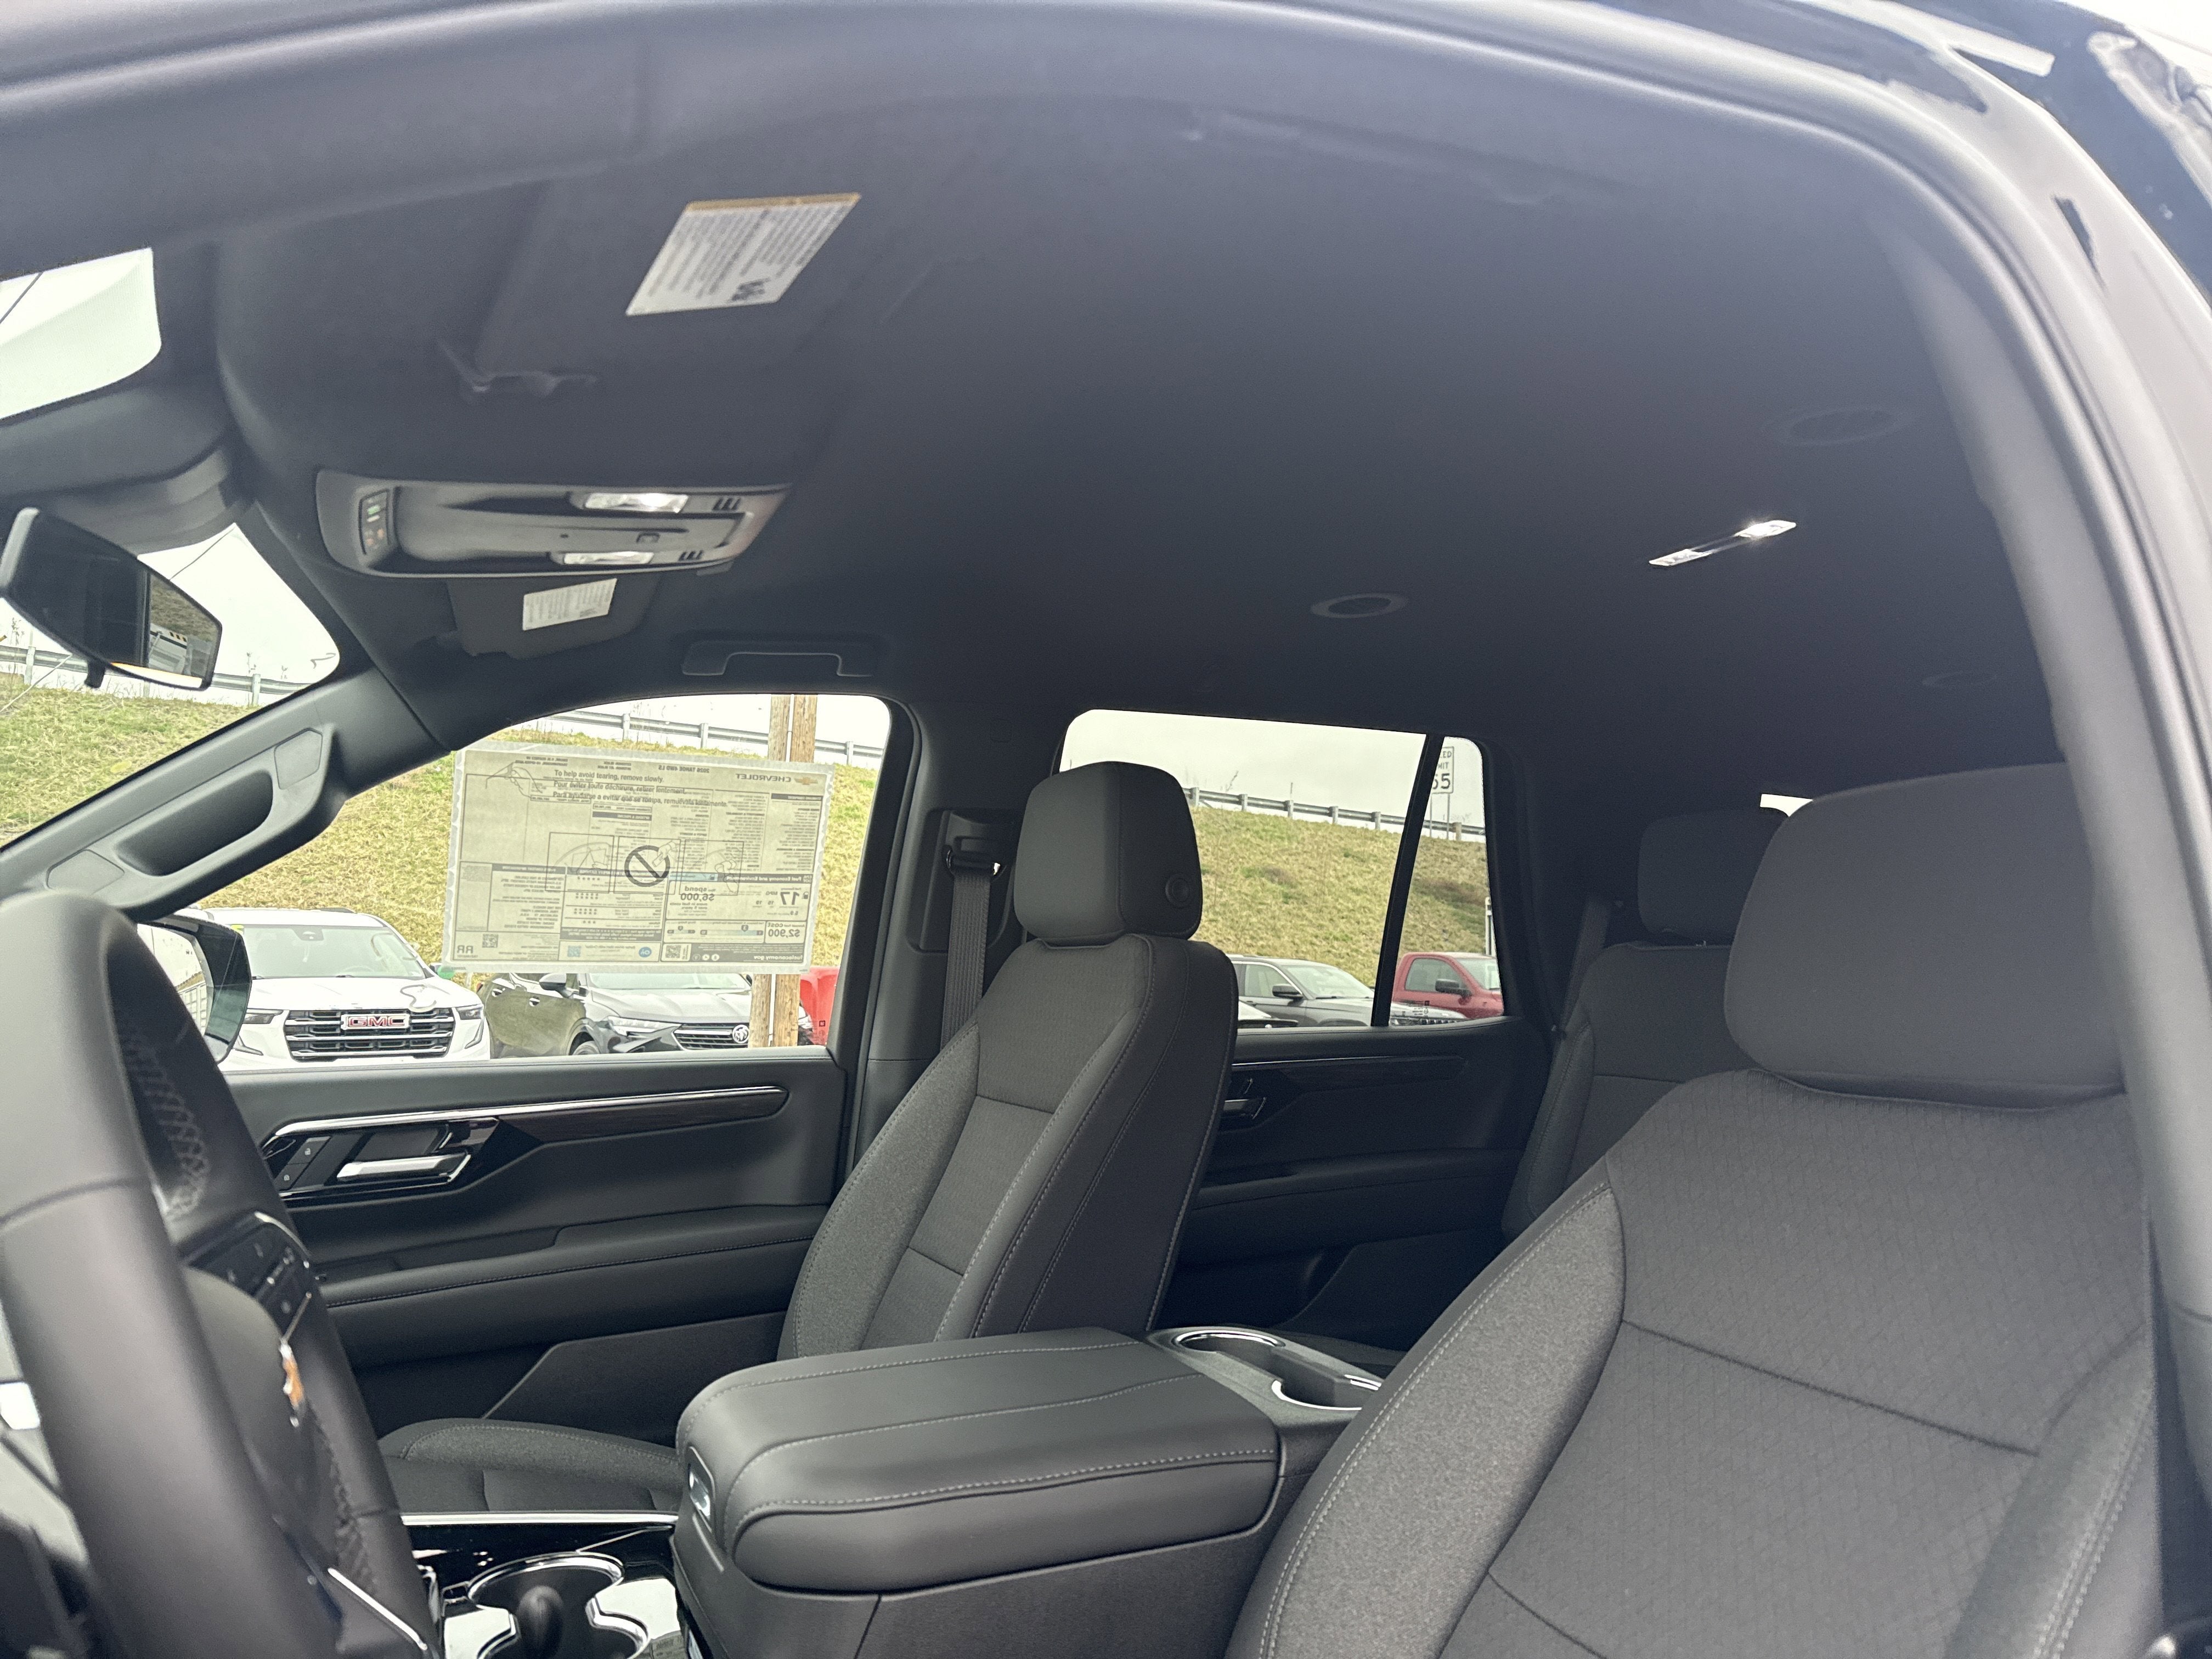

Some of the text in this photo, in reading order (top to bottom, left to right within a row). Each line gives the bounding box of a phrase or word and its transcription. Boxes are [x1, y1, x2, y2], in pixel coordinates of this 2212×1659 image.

[644, 775, 664, 783] slowly.
[568, 792, 595, 800] ayudarse
[347, 1016, 405, 1028] GMC
